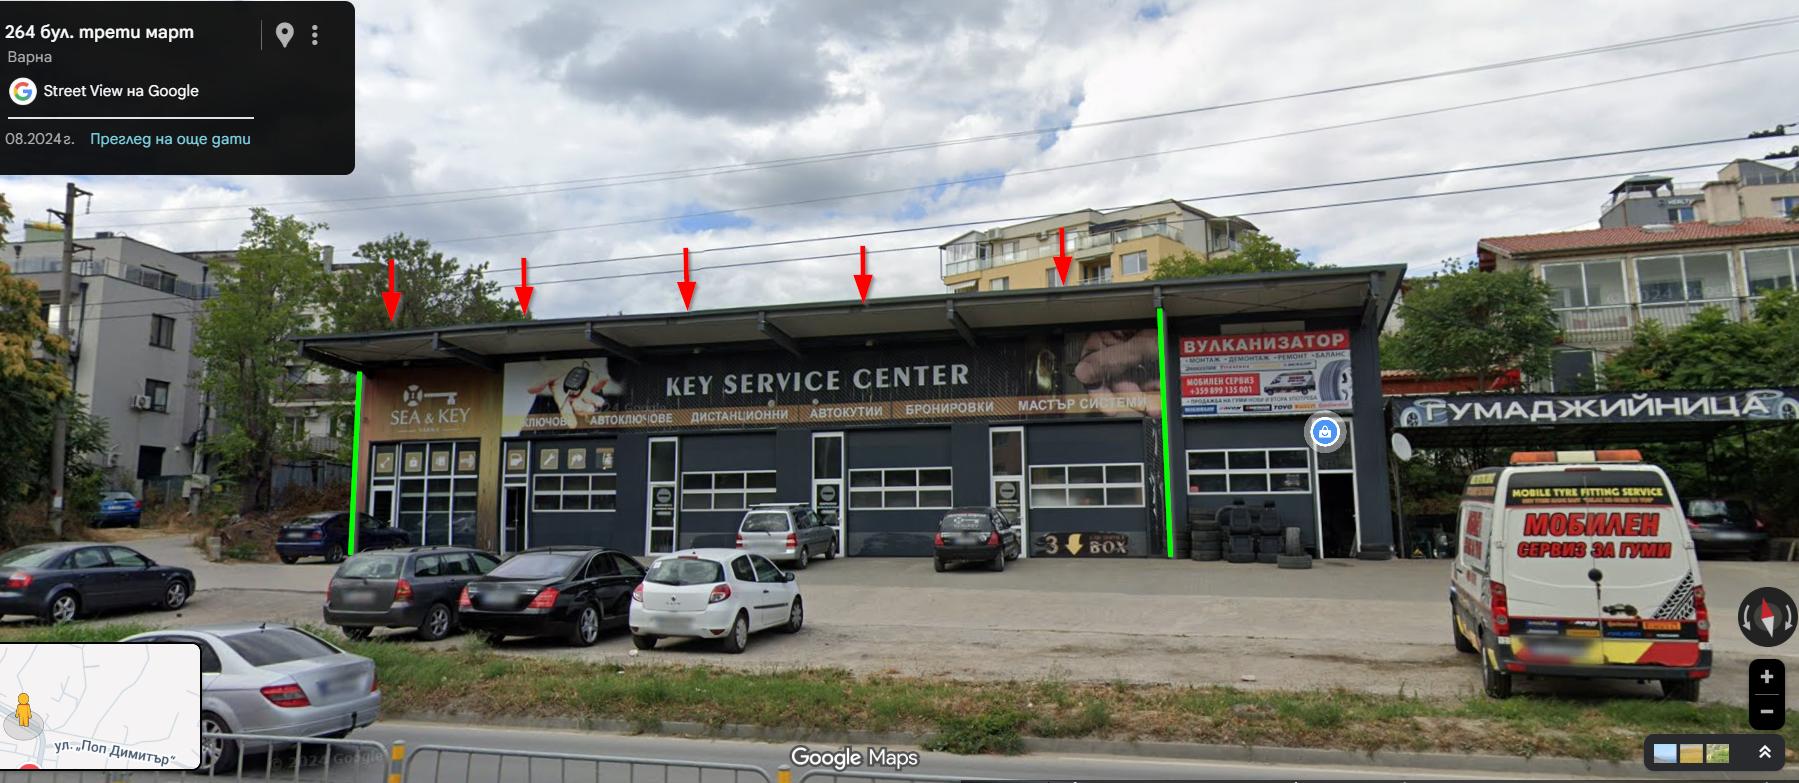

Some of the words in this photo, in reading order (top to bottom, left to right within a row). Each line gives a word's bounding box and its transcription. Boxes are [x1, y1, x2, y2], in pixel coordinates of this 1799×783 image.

[1183, 333, 1345, 354] ВУЛКАНИЗАТОР
[1228, 355, 1270, 363] ДЕМОНТАЖ
[665, 375, 714, 397] KEY
[724, 370, 840, 395] SERVICE
[853, 364, 969, 390] CENTER
[1186, 377, 1224, 386] МОБИЛЕН
[1225, 375, 1255, 385] СЕРВИЗ
[1189, 386, 1209, 395] +359
[1210, 386, 1223, 394] 899
[1225, 385, 1237, 394] 135
[1239, 385, 1253, 393] 001
[390, 409, 421, 426] SEA
[424, 413, 435, 424] &
[439, 407, 471, 424] KEY
[522, 416, 574, 427] КЛЮЧОВЕ
[590, 412, 673, 426] АВТОКЛЮЧОВЕ
[690, 409, 789, 424] ДИСТАНЦИОННИ
[809, 405, 883, 419] АВТОКУТИИ
[906, 401, 994, 415] БРОНИРОВКИ
[1018, 398, 1076, 412] МАСТЪР
[1079, 395, 1147, 410] СИСТЕМИ
[1425, 392, 1772, 423] ГУМАДЖИЙНИЦА
[1512, 488, 1551, 498] MOBILE
[1553, 488, 1578, 497] TYRE
[1580, 487, 1620, 497] FITTING
[1623, 487, 1664, 497] SERVICE
[1524, 512, 1660, 537] МОБИЛЕН
[1045, 535, 1059, 555] 3
[1090, 540, 1127, 554] BOX
[1517, 541, 1587, 559] СЕРВИЗ
[1591, 541, 1615, 558] ЗА
[1619, 541, 1672, 559] ГУМИ
